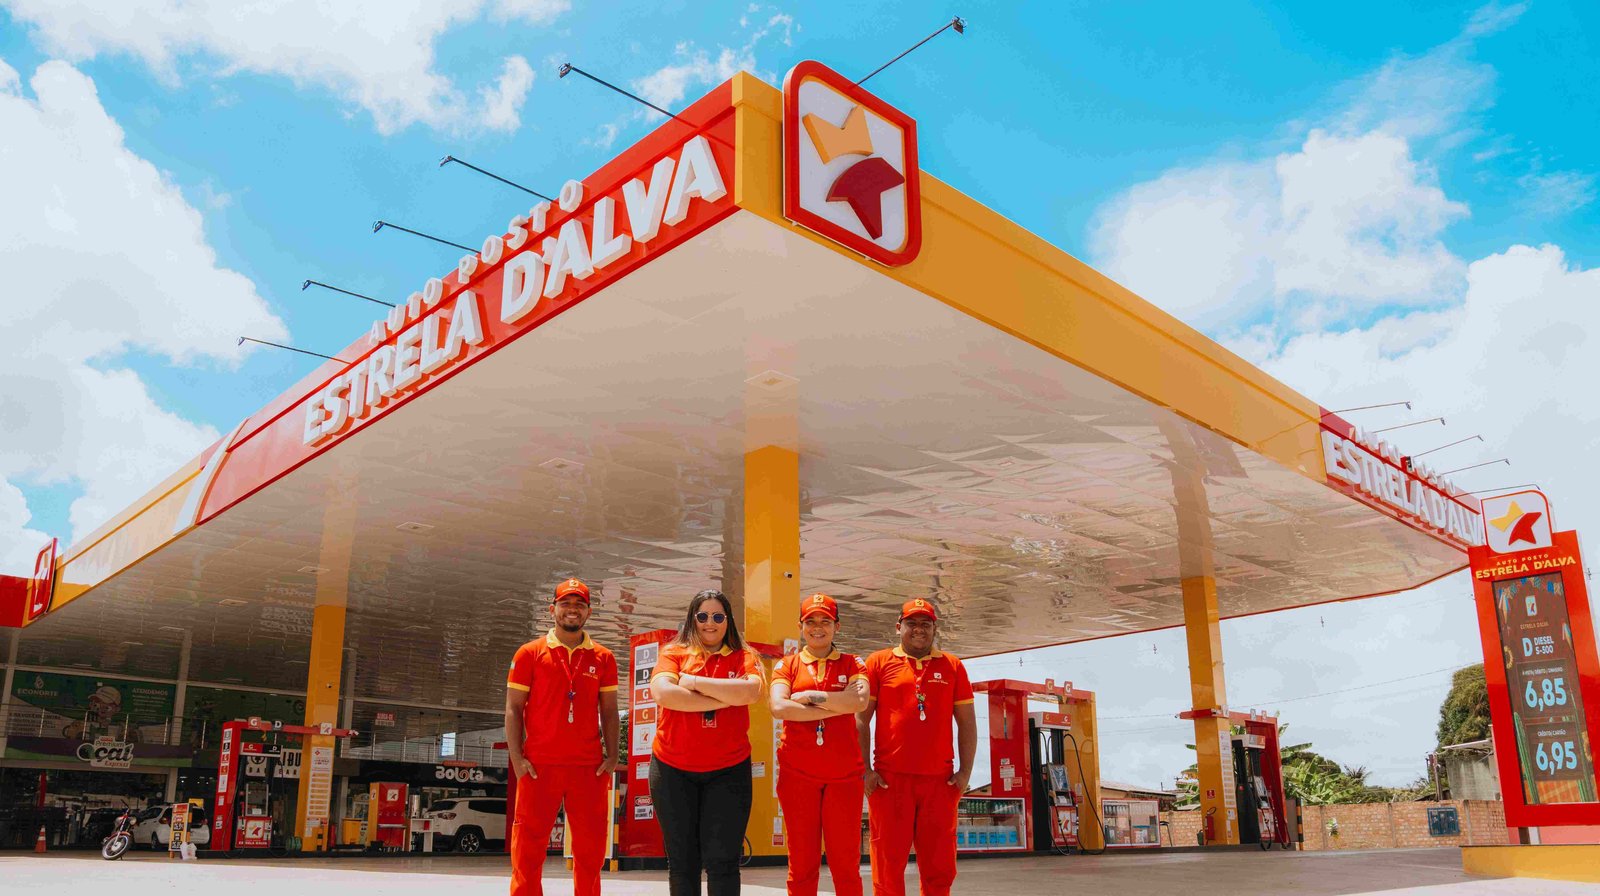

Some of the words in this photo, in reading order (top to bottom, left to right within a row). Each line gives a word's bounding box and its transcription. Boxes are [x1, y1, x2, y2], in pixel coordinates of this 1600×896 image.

[368, 277, 444, 346] AUTO
[458, 179, 586, 285] POSTO
[302, 290, 485, 446] ESTRELA
[500, 134, 727, 325] D'ALVA
[1320, 430, 1431, 522] ESTRELA
[1496, 558, 1518, 566] AUTO
[1521, 553, 1549, 562] POSTO
[1475, 564, 1530, 579] ESTRELA
[1533, 556, 1576, 571] D'ALVA
[1533, 635, 1555, 645] DIESEL
[1522, 637, 1533, 657] D
[1535, 645, 1554, 655] S-500
[643, 649, 650, 659] D
[642, 669, 650, 680] D
[1047, 680, 1053, 691] G
[1065, 683, 1071, 693] G
[17, 688, 59, 697] ECONORTE
[642, 688, 649, 700] G
[1525, 677, 1567, 712] 6,85
[642, 709, 649, 720] G
[250, 718, 258, 726] G
[274, 720, 282, 728] D
[1535, 741, 1578, 776] 6,95
